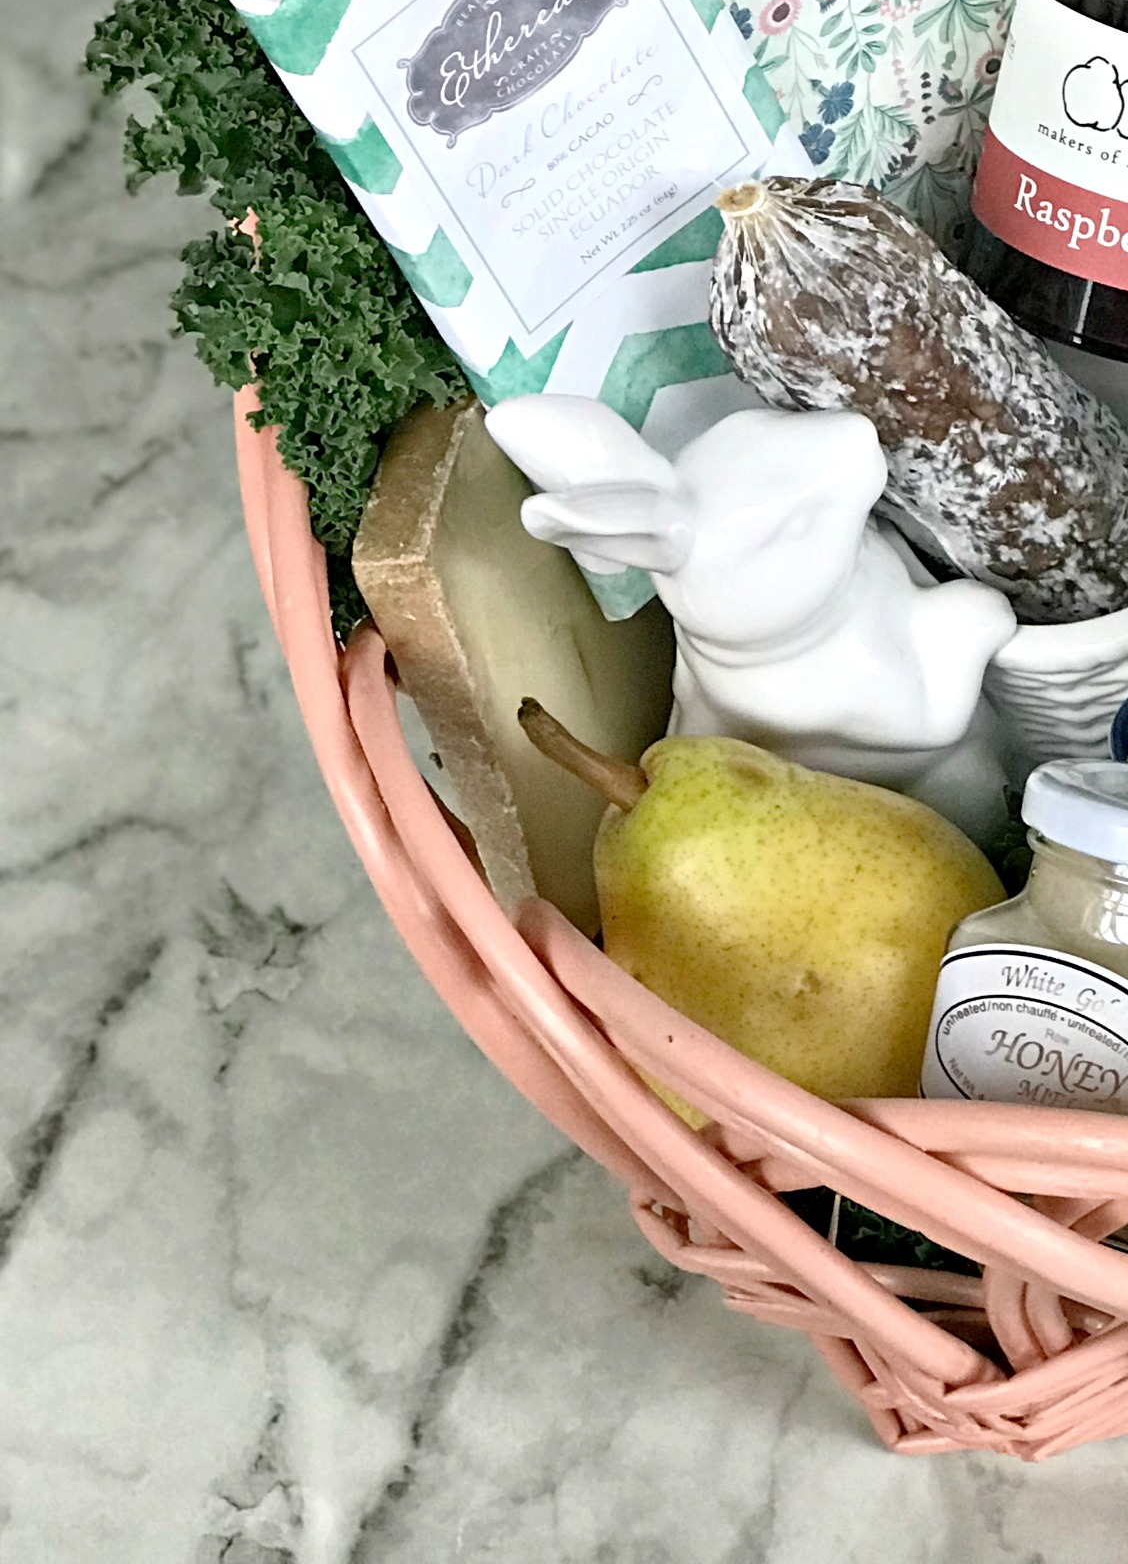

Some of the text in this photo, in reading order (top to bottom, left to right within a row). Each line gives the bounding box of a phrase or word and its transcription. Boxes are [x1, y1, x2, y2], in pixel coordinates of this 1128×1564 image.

[496, 32, 573, 98] CHOCOLATE
[466, 44, 658, 198] Dark Chocolate
[568, 112, 615, 152] CACAO
[1037, 122, 1094, 156] makers
[1100, 149, 1122, 164] of
[512, 99, 678, 237] SOLID CHOCOLATE
[539, 129, 671, 241] SINGLE ORIGIN
[568, 163, 661, 241] ECUADOR
[580, 244, 602, 265] Net
[638, 204, 652, 218] oz
[1001, 964, 1066, 997] White
[1015, 1003, 1058, 1022] chauffé
